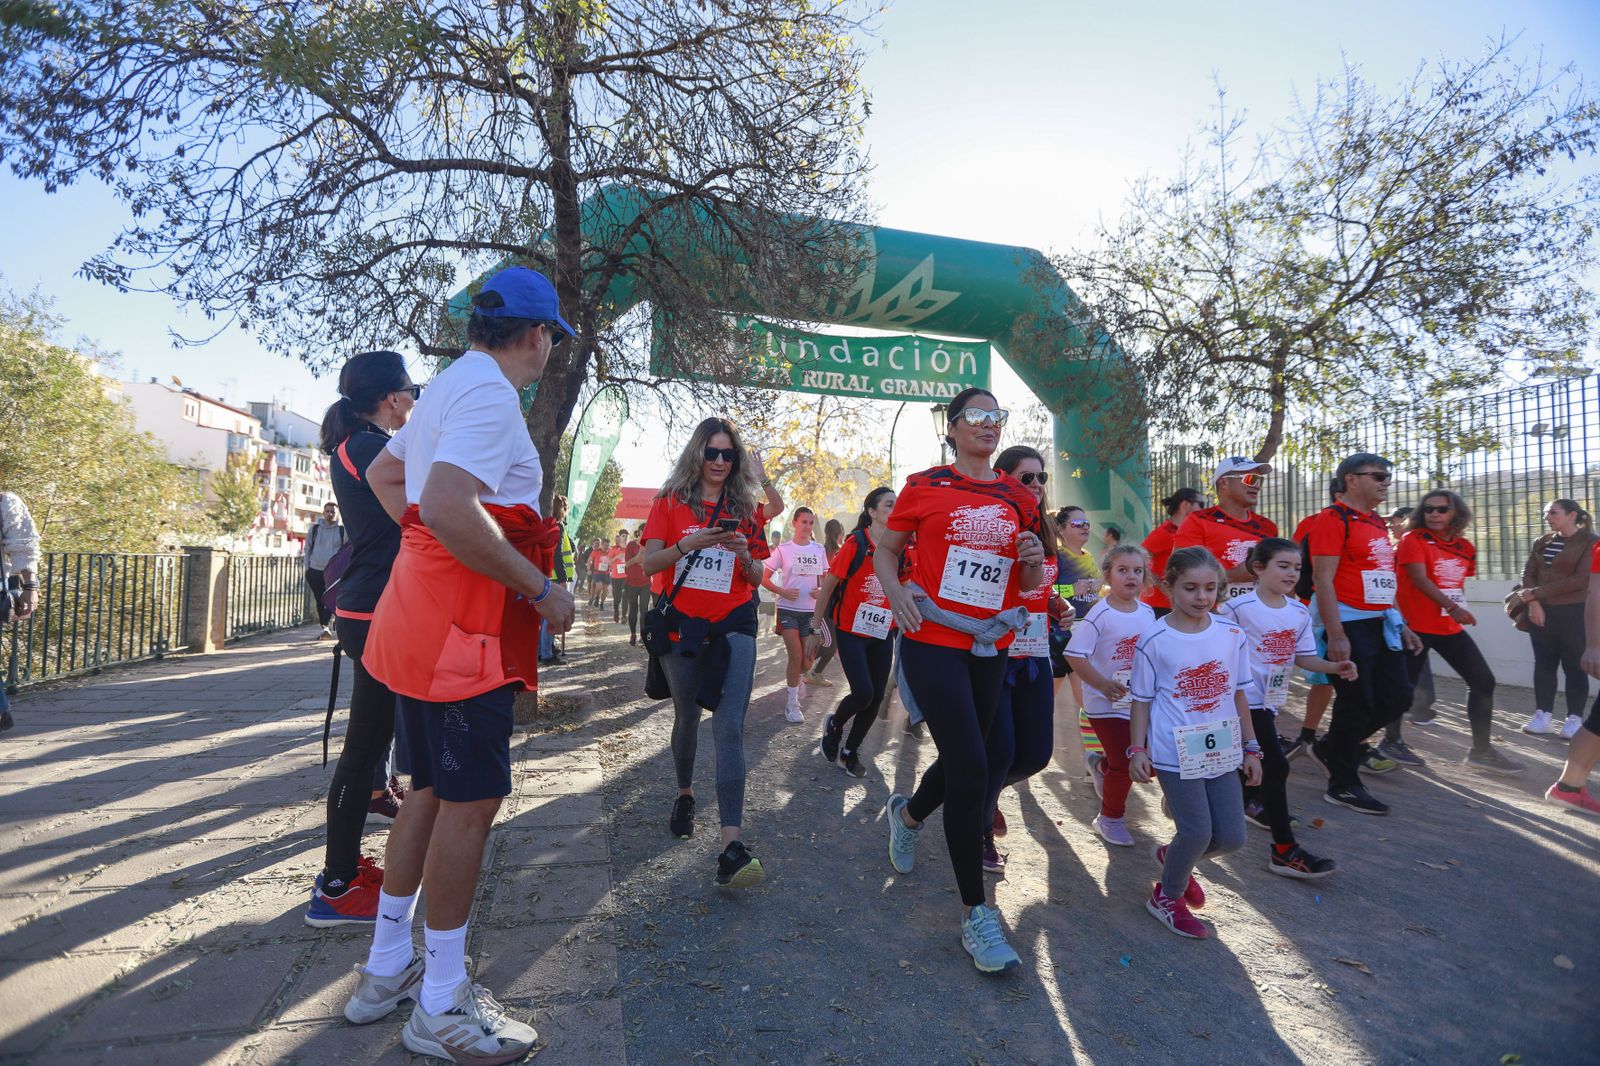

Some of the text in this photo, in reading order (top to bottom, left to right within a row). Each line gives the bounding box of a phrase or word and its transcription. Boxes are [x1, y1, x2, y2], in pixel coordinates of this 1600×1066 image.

[801, 369, 875, 395] RURAL
[880, 378, 974, 399] GRANAD
[797, 557, 818, 565] 1363
[957, 559, 1001, 584] 1782
[861, 610, 886, 625] 1164
[1205, 733, 1216, 750] 6
